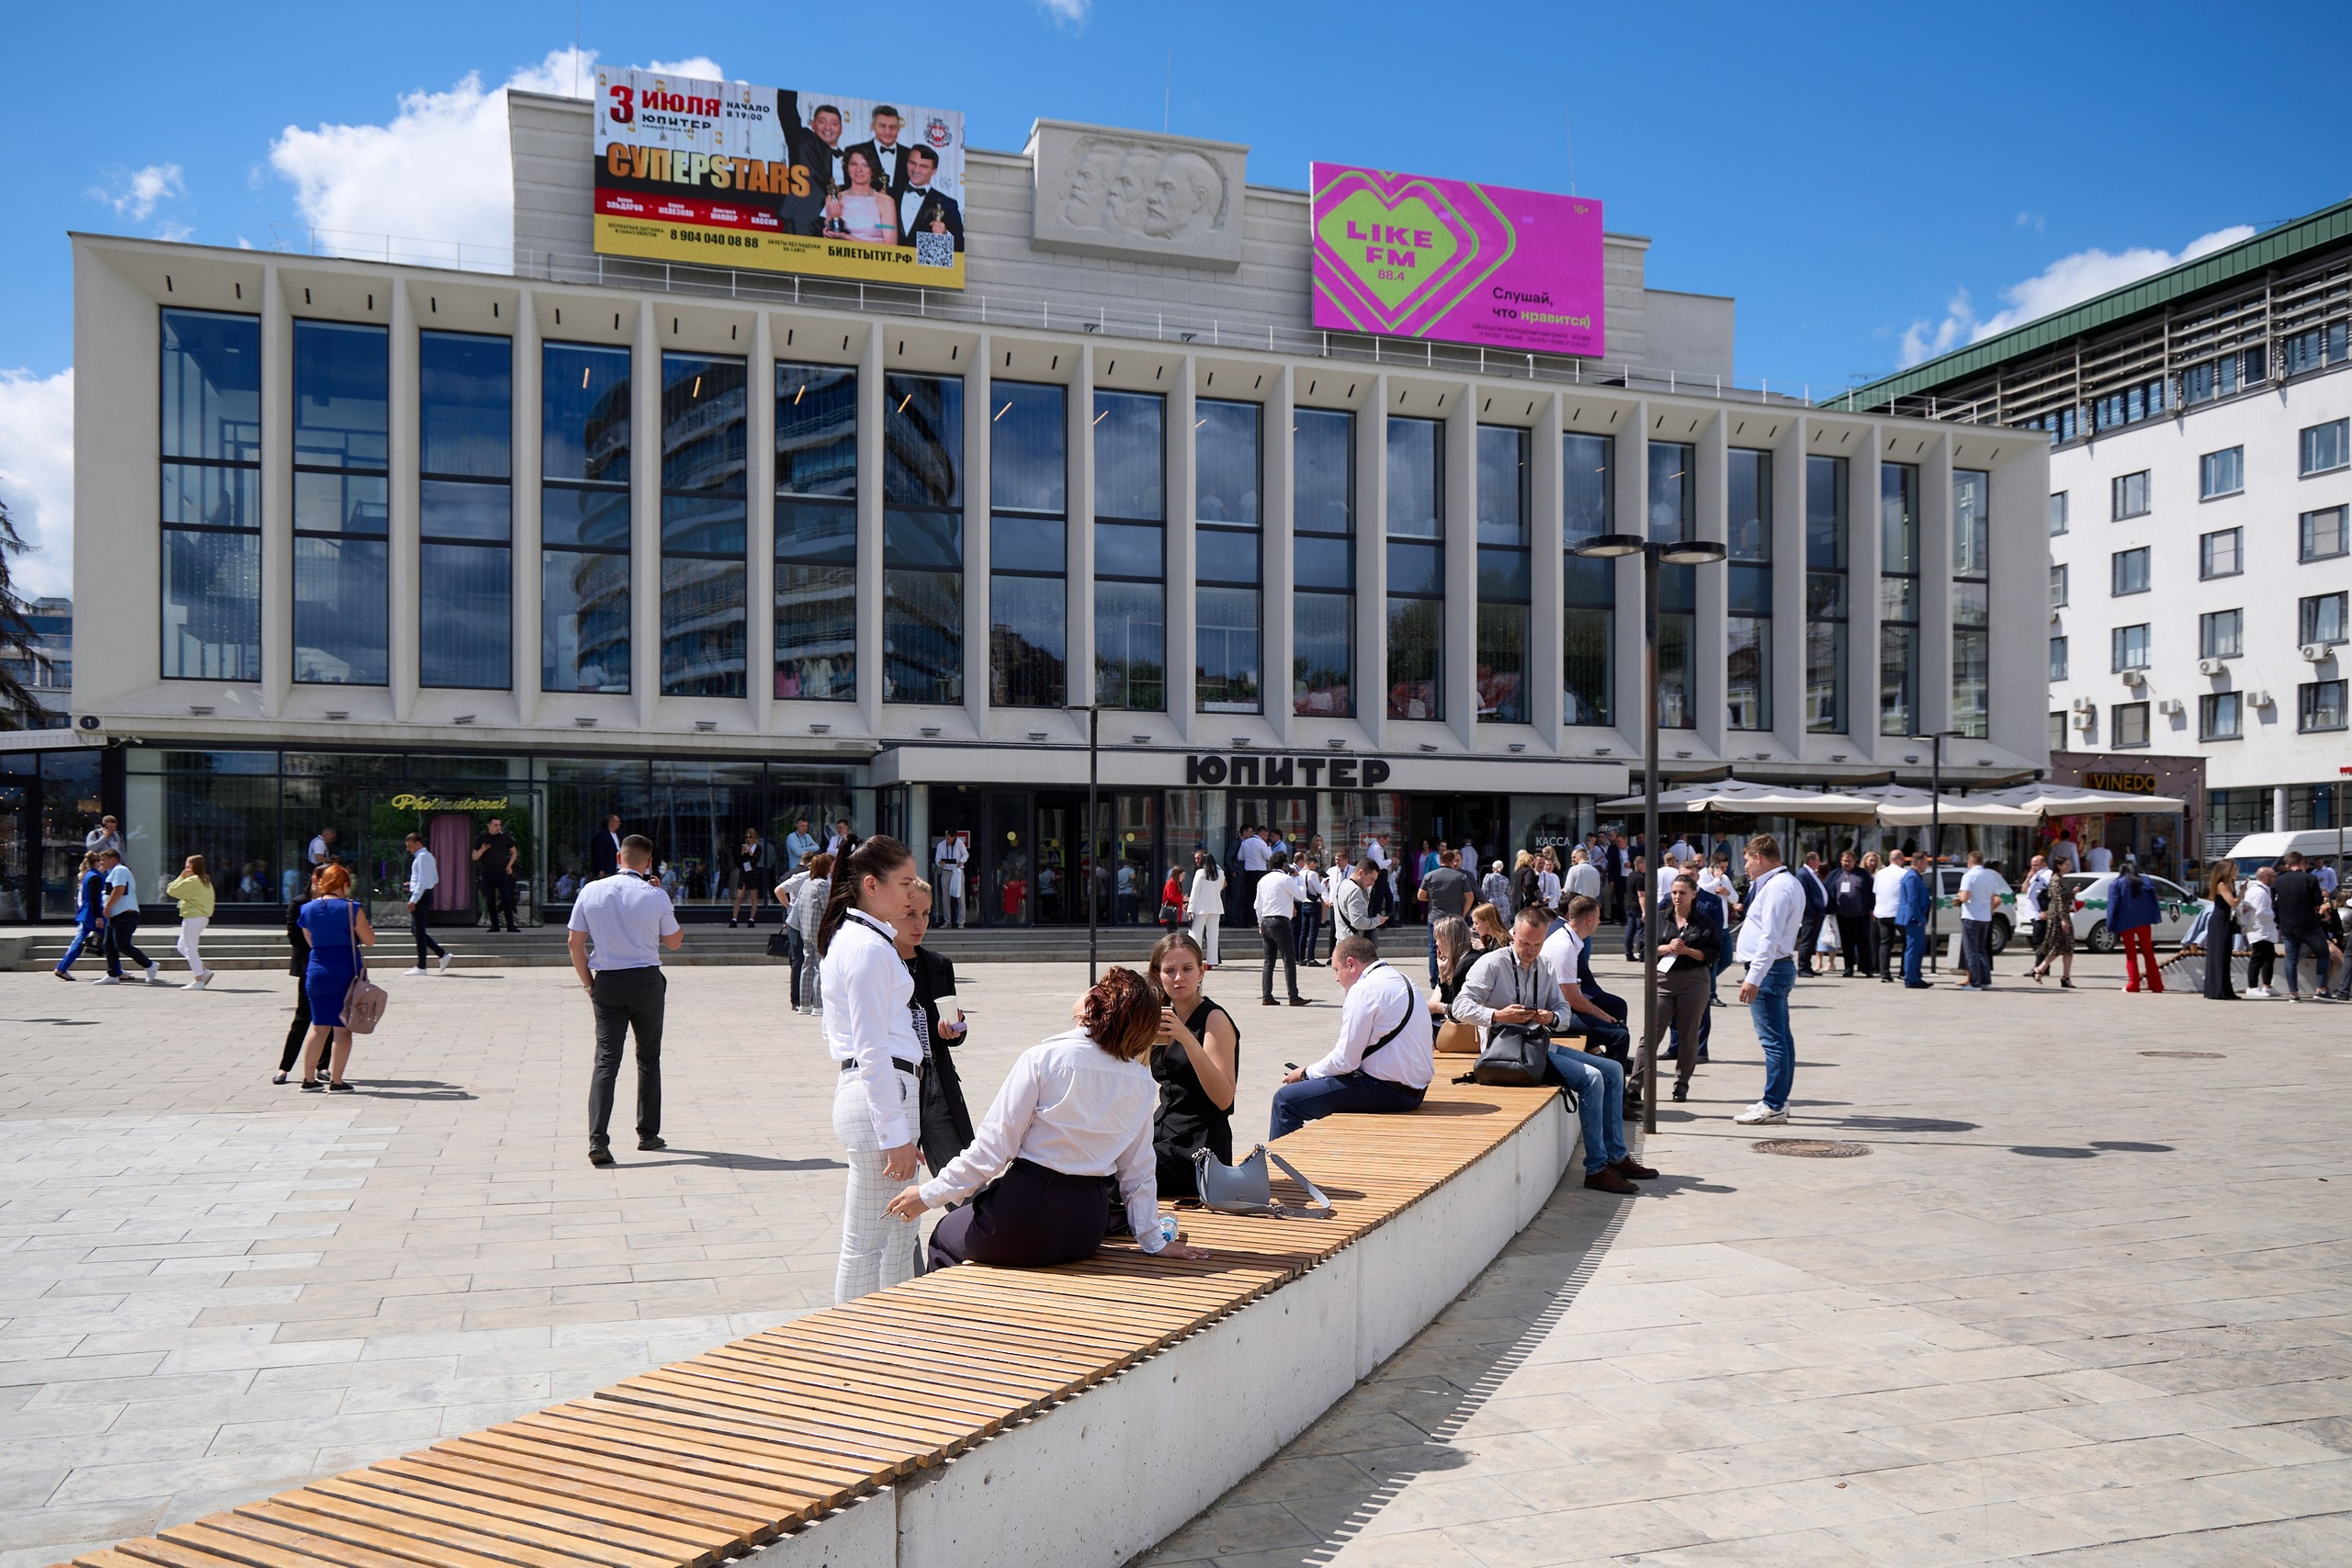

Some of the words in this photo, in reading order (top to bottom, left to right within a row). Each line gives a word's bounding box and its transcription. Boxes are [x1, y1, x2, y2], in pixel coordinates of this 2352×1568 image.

[610, 85, 634, 124] 3
[641, 89, 720, 118] ИЮЛЯ
[727, 101, 770, 114] НАЧАЛО
[642, 114, 711, 130] ЮПИТЕР
[736, 111, 763, 121] 19:00
[670, 229, 677, 240] 8
[680, 230, 701, 243] 904
[704, 232, 725, 245] 040
[728, 234, 741, 247] 08
[744, 236, 759, 248] 88
[1347, 220, 1433, 249] LIKE
[828, 245, 912, 265] БИЛЕТЫТУТ.РФ
[1366, 245, 1416, 268] FM
[1377, 269, 1405, 281] 88.4
[1492, 287, 1554, 307] Слушай,
[1492, 308, 1518, 319] что
[1521, 310, 1591, 330] нравится)
[1187, 755, 1391, 787] ЮПИТЕР
[2093, 773, 2157, 792] VINEDO
[390, 794, 509, 810] Photoautomat
[1535, 836, 1571, 847] КАССА
